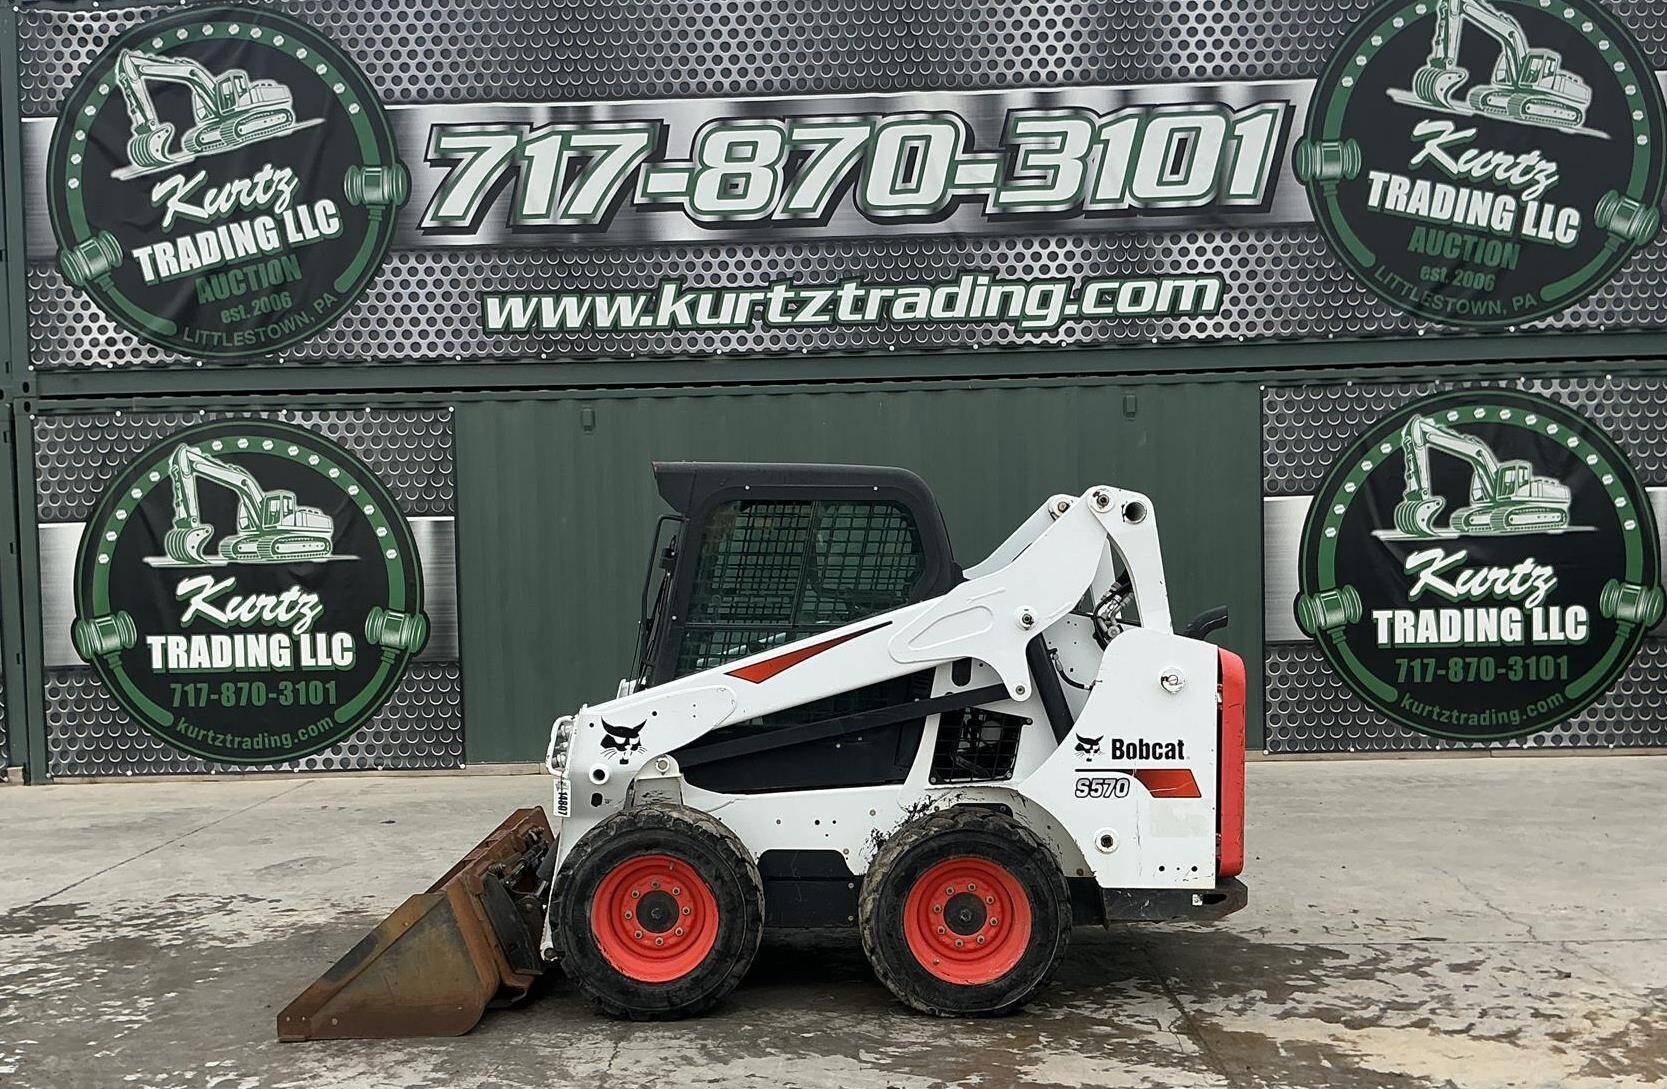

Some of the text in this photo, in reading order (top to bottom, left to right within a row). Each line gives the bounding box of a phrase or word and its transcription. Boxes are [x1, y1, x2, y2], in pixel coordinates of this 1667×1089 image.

[422, 101, 1288, 230] 717-870-3101
[1411, 120, 1559, 201] Kurtz
[151, 164, 298, 228] Kurtz
[1367, 171, 1581, 246] TRADING LLC
[133, 199, 341, 282] TRADING LLC
[1408, 227, 1521, 270] AUCTION
[195, 255, 301, 304] AUCTION
[1420, 265, 1496, 292] est. 2006
[183, 293, 338, 347] LITTLESTOWN, PA
[221, 292, 293, 324] est. 2006
[485, 274, 1223, 332] www.kurtztrading.com
[1512, 293, 1538, 312] PA
[1404, 549, 1558, 608] Kurtz
[176, 574, 323, 634] Kurtz
[1373, 605, 1588, 645] TRADING LLC
[146, 632, 354, 670] TRADING LLC
[1395, 655, 1569, 683] 717-870-3101
[170, 680, 337, 708] 717-870-3101
[1400, 692, 1564, 726] kurtztrading.com
[176, 715, 333, 750] kurtztrading.com
[1111, 738, 1185, 760] Bobcat
[557, 792, 568, 816] 14807
[1074, 778, 1130, 798] S570
